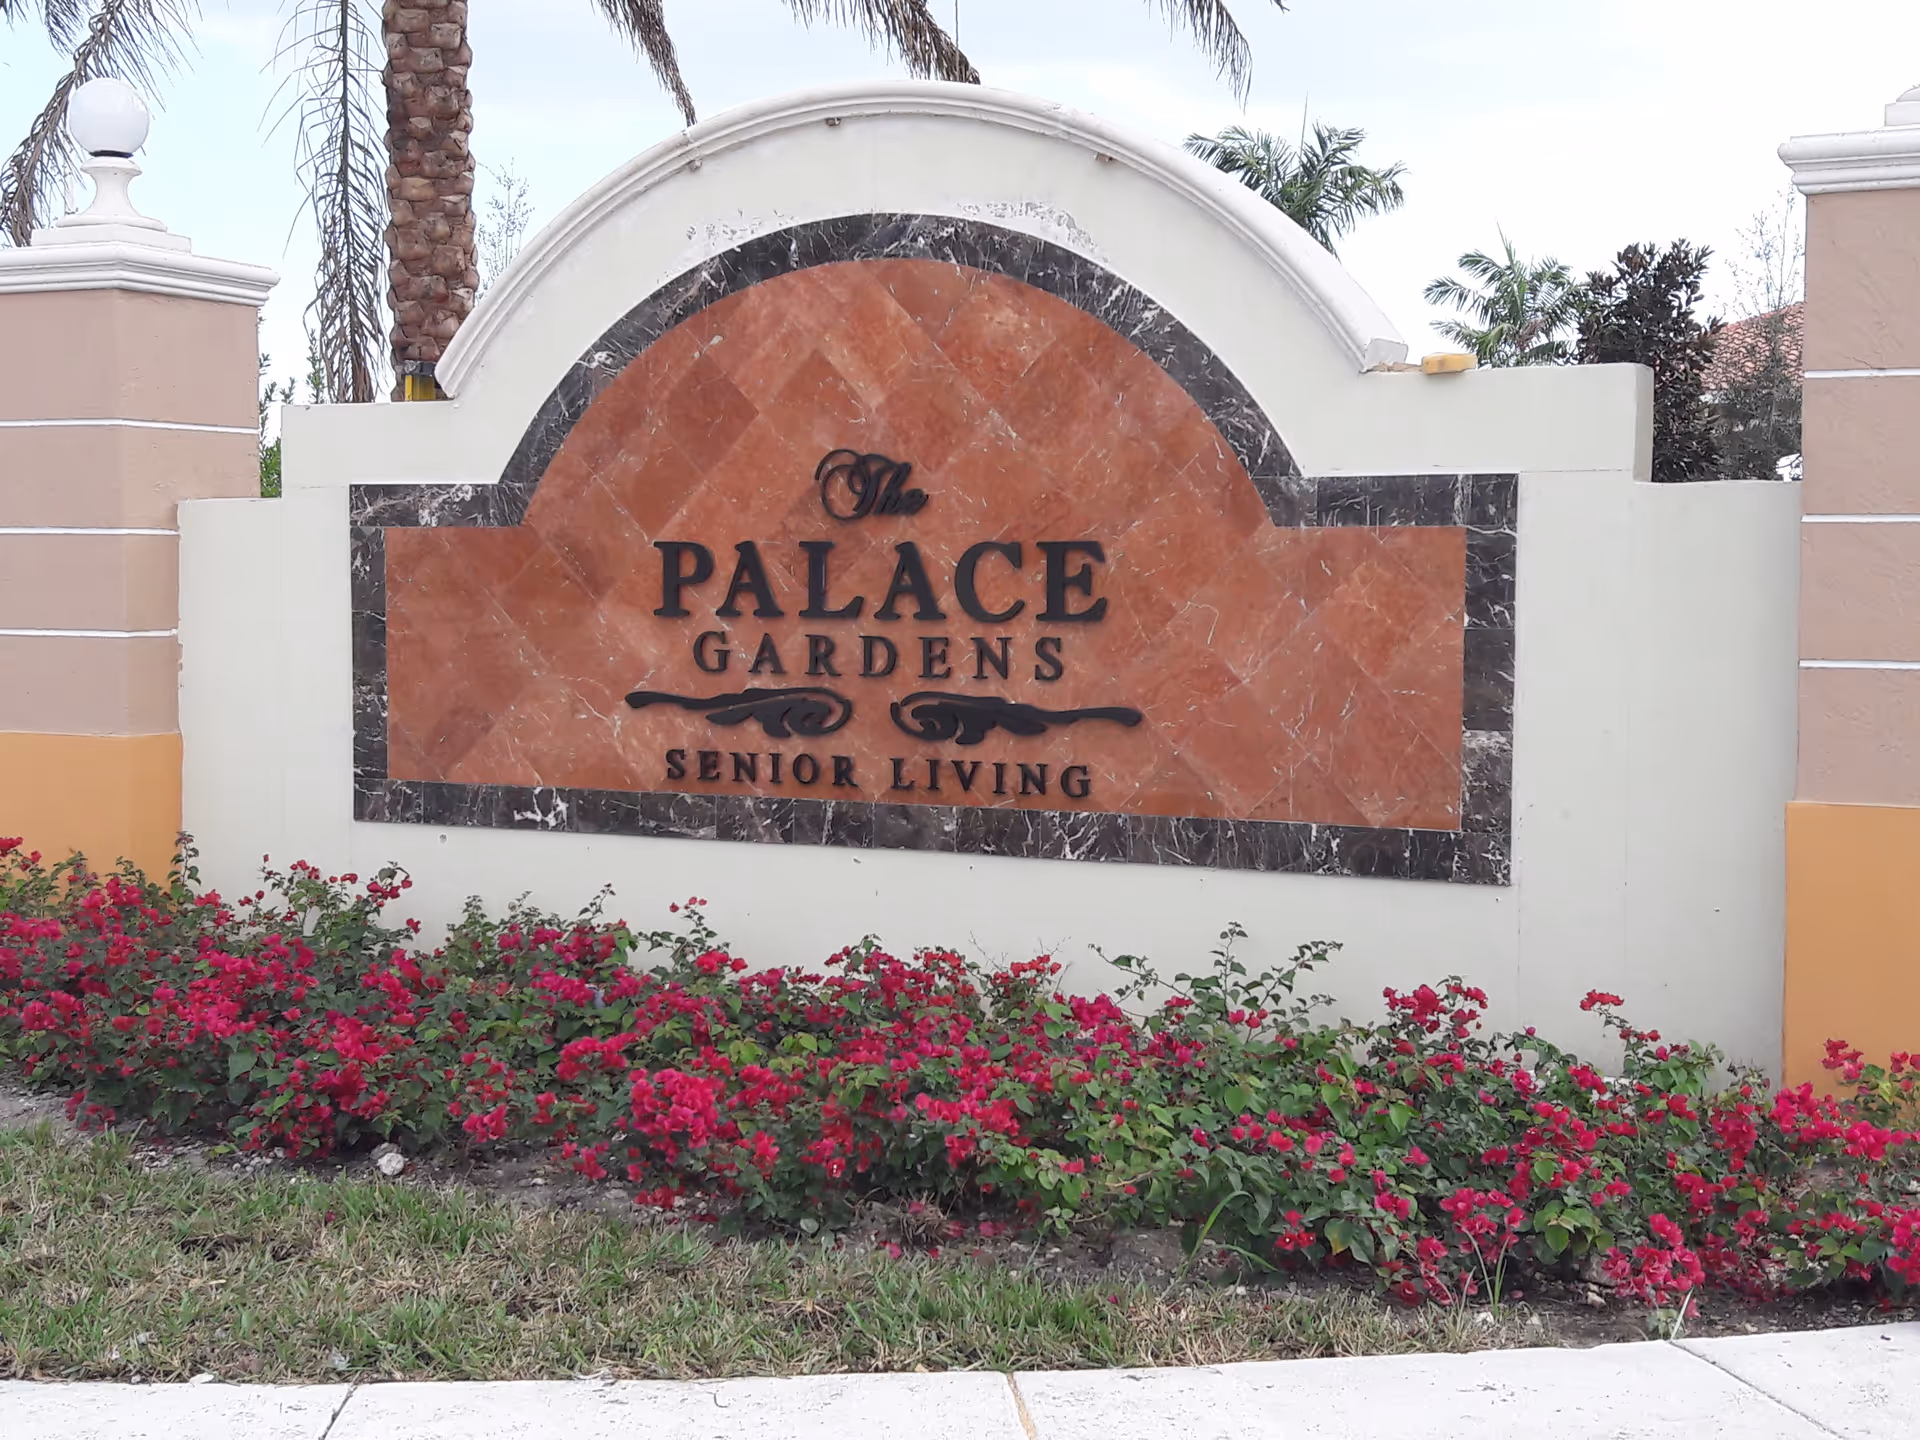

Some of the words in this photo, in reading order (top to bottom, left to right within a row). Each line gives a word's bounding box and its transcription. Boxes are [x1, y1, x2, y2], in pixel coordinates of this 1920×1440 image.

[815, 448, 929, 521] The
[653, 540, 1108, 625] PALACE
[693, 630, 1064, 682] GARDENS
[665, 748, 860, 790] SENIOR
[889, 756, 1092, 799] LIVING
